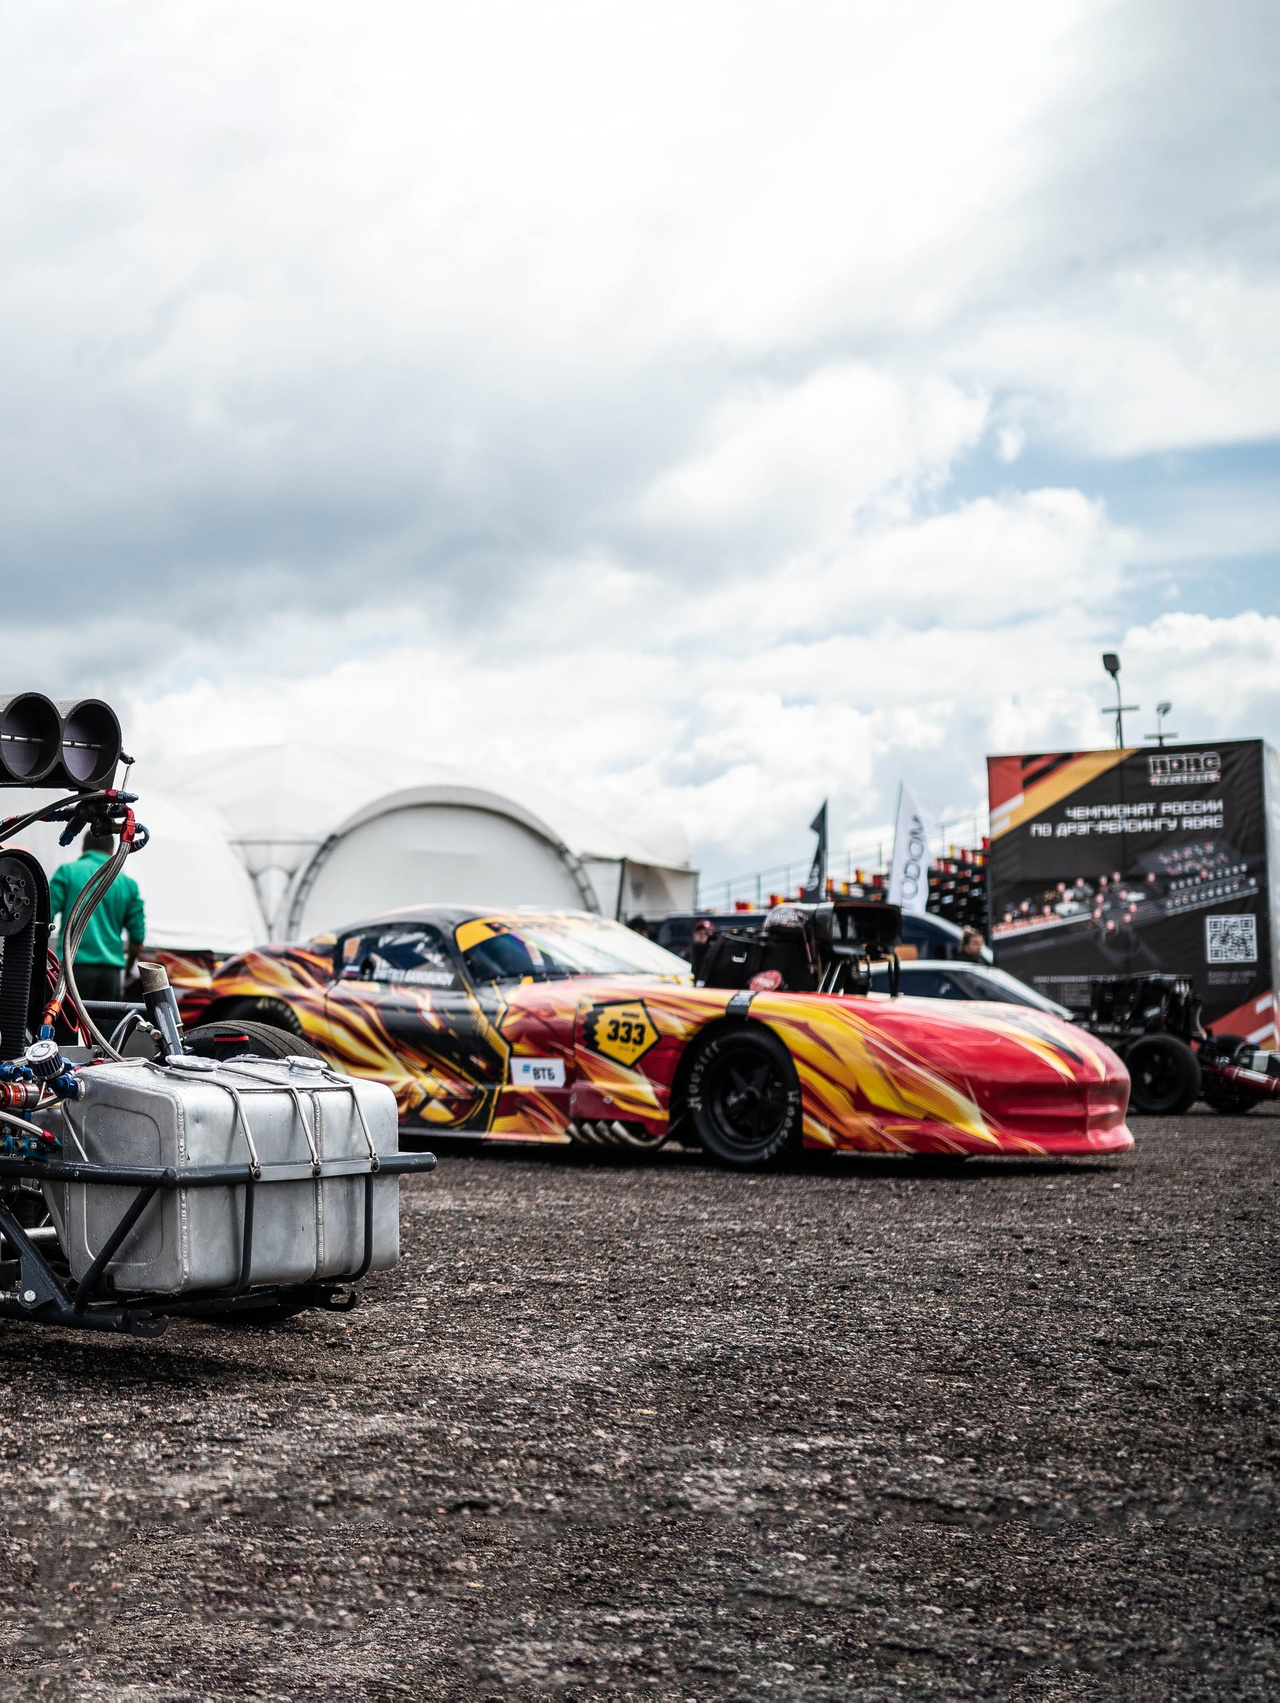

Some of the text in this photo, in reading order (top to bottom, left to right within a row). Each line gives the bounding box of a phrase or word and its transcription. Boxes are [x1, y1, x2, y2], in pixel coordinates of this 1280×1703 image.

[1149, 752, 1221, 776] RDRC
[1065, 799, 1224, 821] ЧЕМПИОНАТ РОССИИ
[1030, 822, 1053, 838] ПО
[1055, 817, 1178, 838] ДРЭГ-РЕЙСИНГУ
[607, 1019, 646, 1047] 333
[532, 1066, 556, 1081] ВТБ
